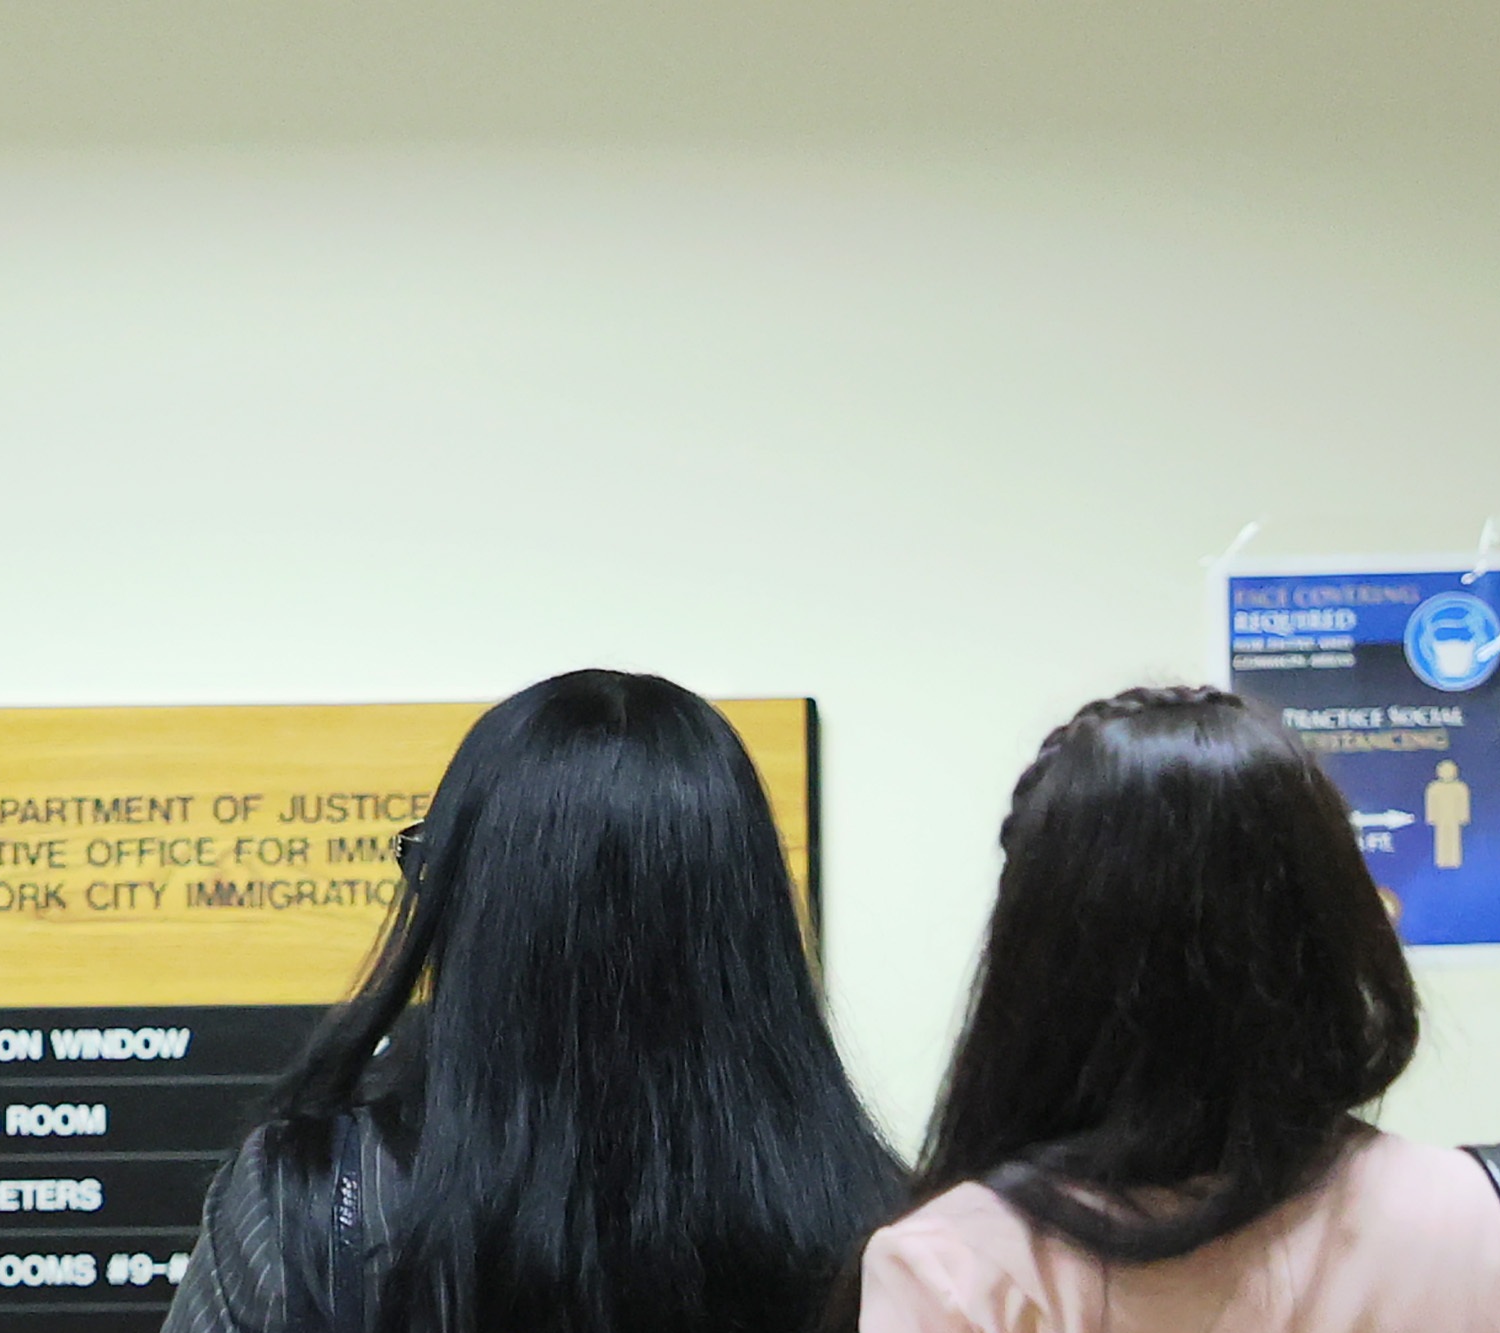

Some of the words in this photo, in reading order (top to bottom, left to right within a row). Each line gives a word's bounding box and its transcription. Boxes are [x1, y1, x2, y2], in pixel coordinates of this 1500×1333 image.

[212, 794, 263, 824] OF
[279, 794, 431, 824] JUSTICE
[85, 837, 216, 868] OFFICE
[233, 836, 310, 866] FOR
[327, 836, 399, 864] IMM
[85, 881, 167, 911] CITY
[186, 879, 396, 912] IMMIGRATIO
[50, 1027, 191, 1060] WINDOW
[5, 1103, 107, 1137] ROOM
